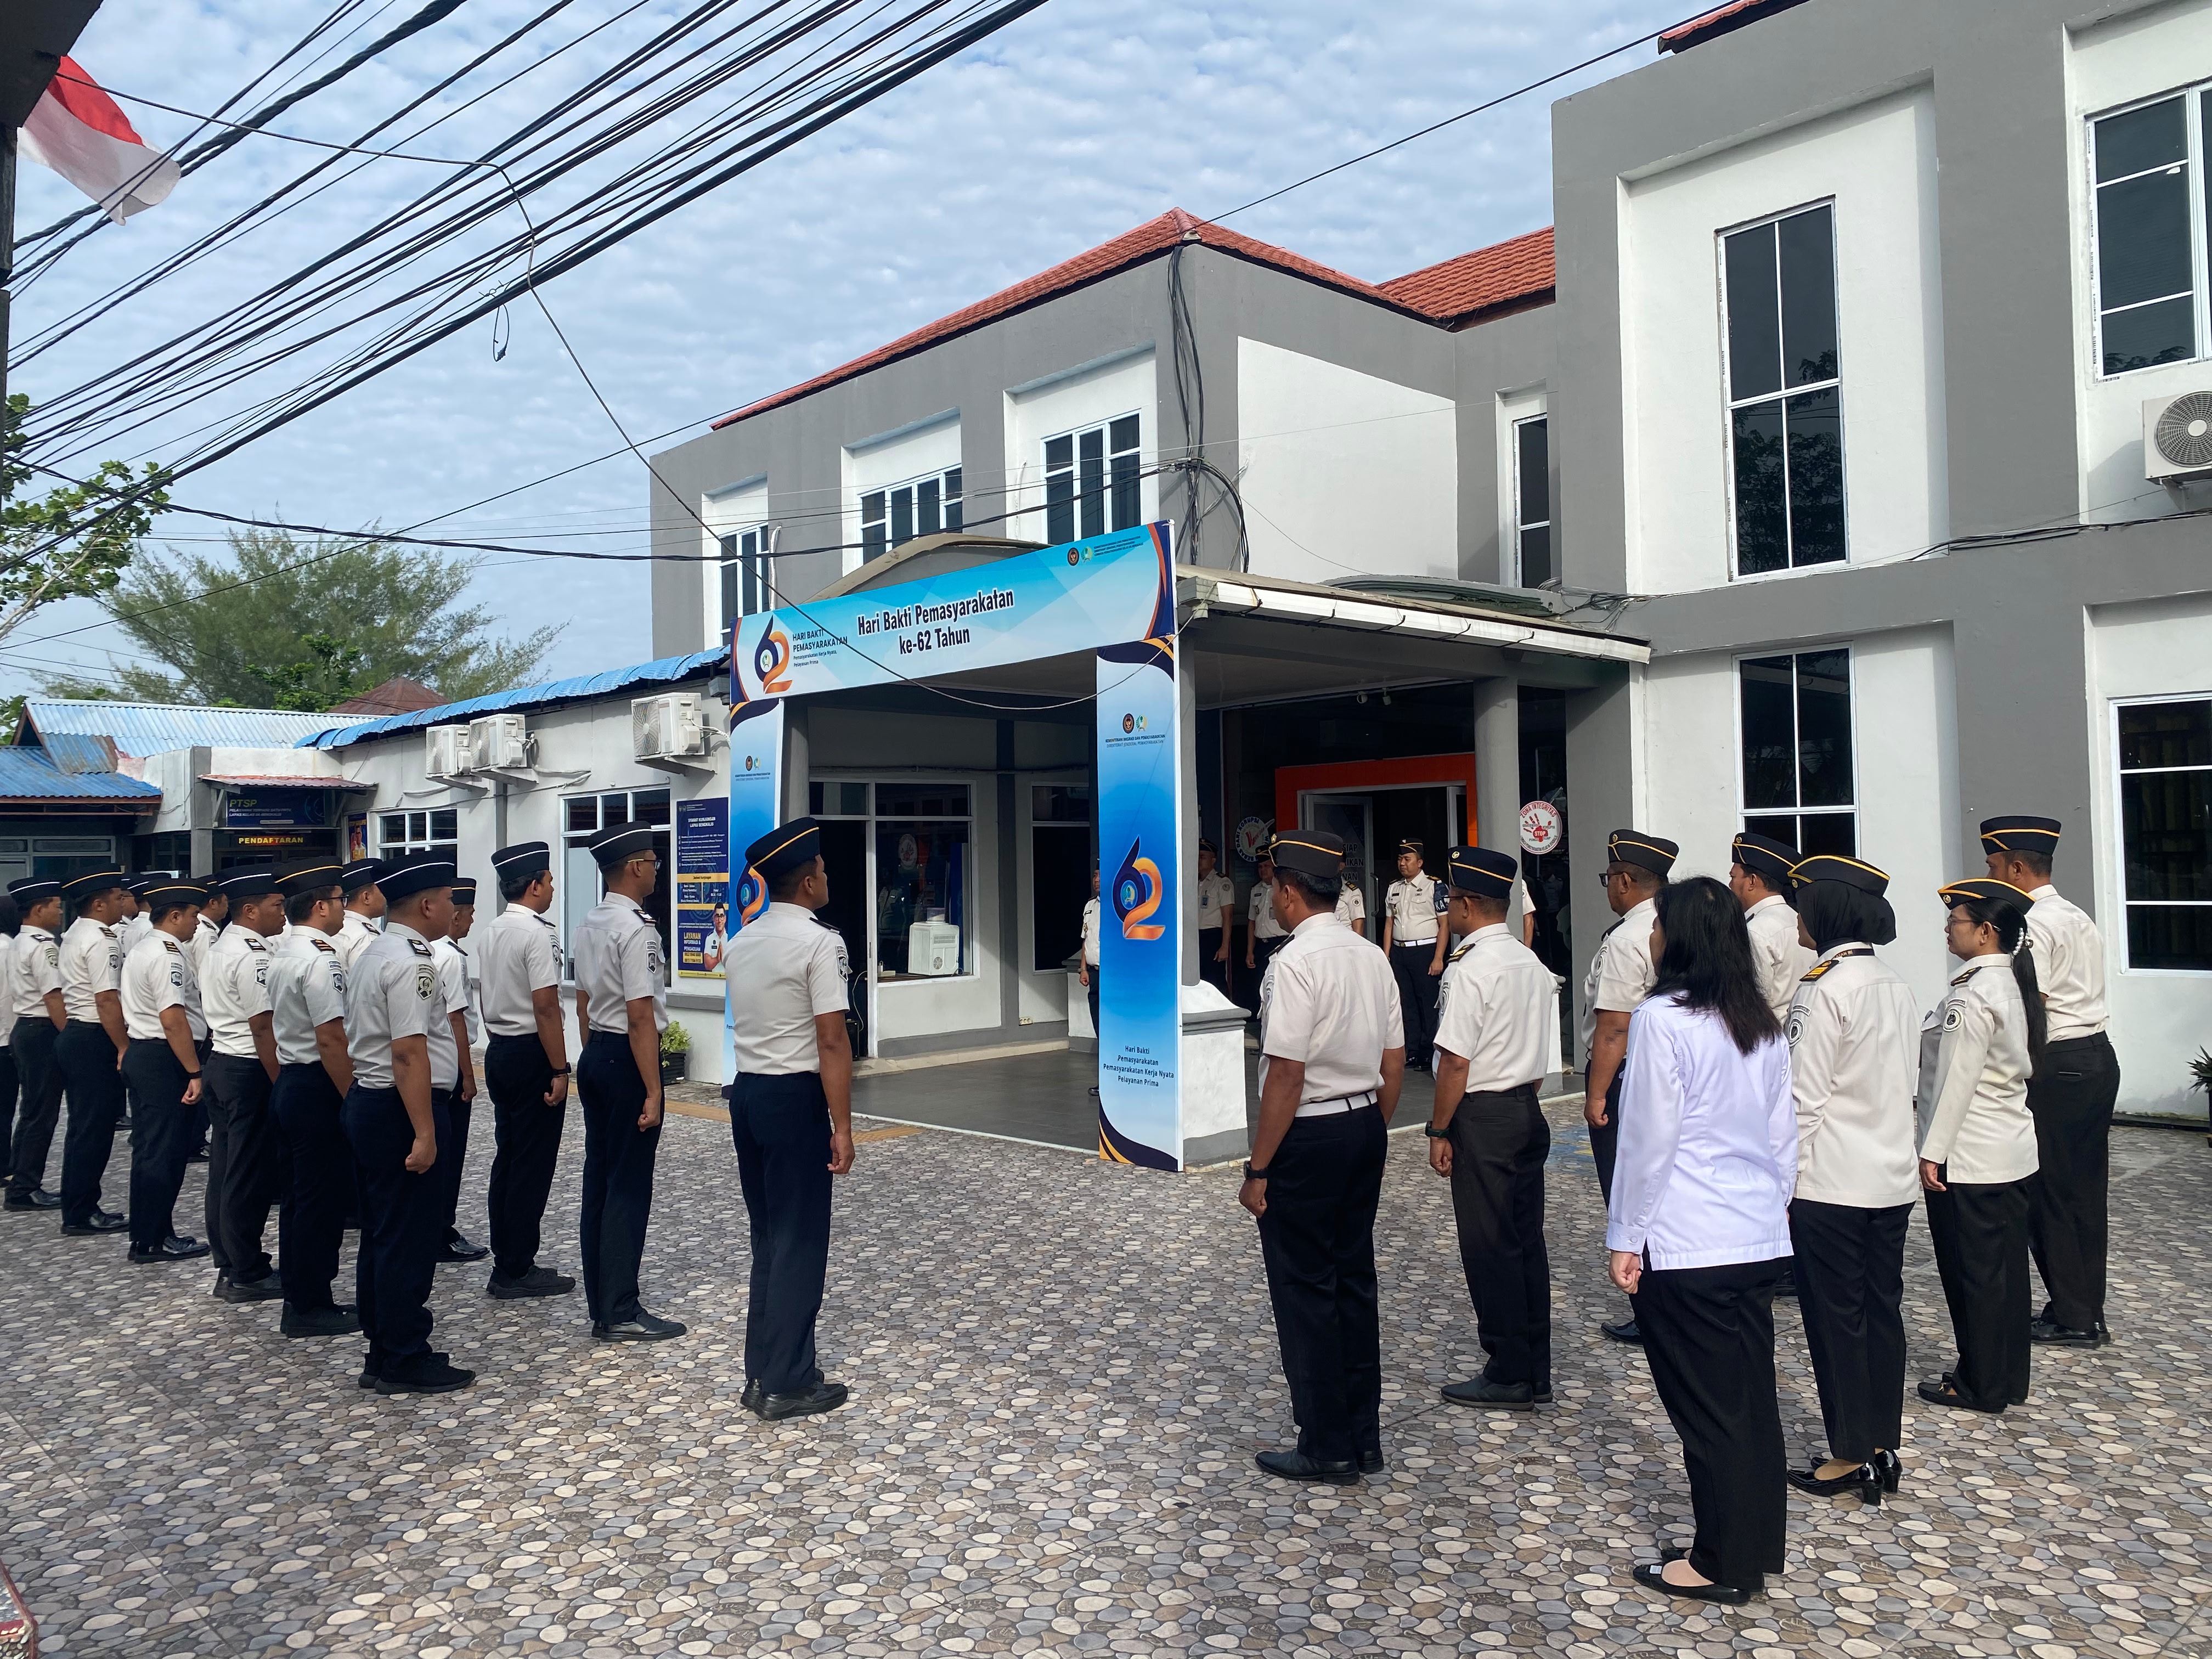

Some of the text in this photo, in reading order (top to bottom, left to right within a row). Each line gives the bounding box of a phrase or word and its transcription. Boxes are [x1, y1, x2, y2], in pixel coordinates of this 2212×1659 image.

[857, 589, 1014, 635] Hari Bakti Pemasyarakatan
[793, 629, 823, 641] HARI BAKTI
[899, 626, 970, 654] ke-62 Tahun
[793, 636, 848, 652] PEMASYARAKATAN
[229, 799, 257, 808] PTSP
[1520, 803, 1557, 819] ZONA INTEGRITAS
[1238, 817, 1260, 831] KORUPSI
[1342, 844, 1358, 852] SIAP
[1118, 1055, 1159, 1066] Pemasyarakatan
[1103, 1063, 1174, 1079] Pemasyarakatan Kerja Nyata
[1118, 1075, 1159, 1087] Pelayanan Prima
